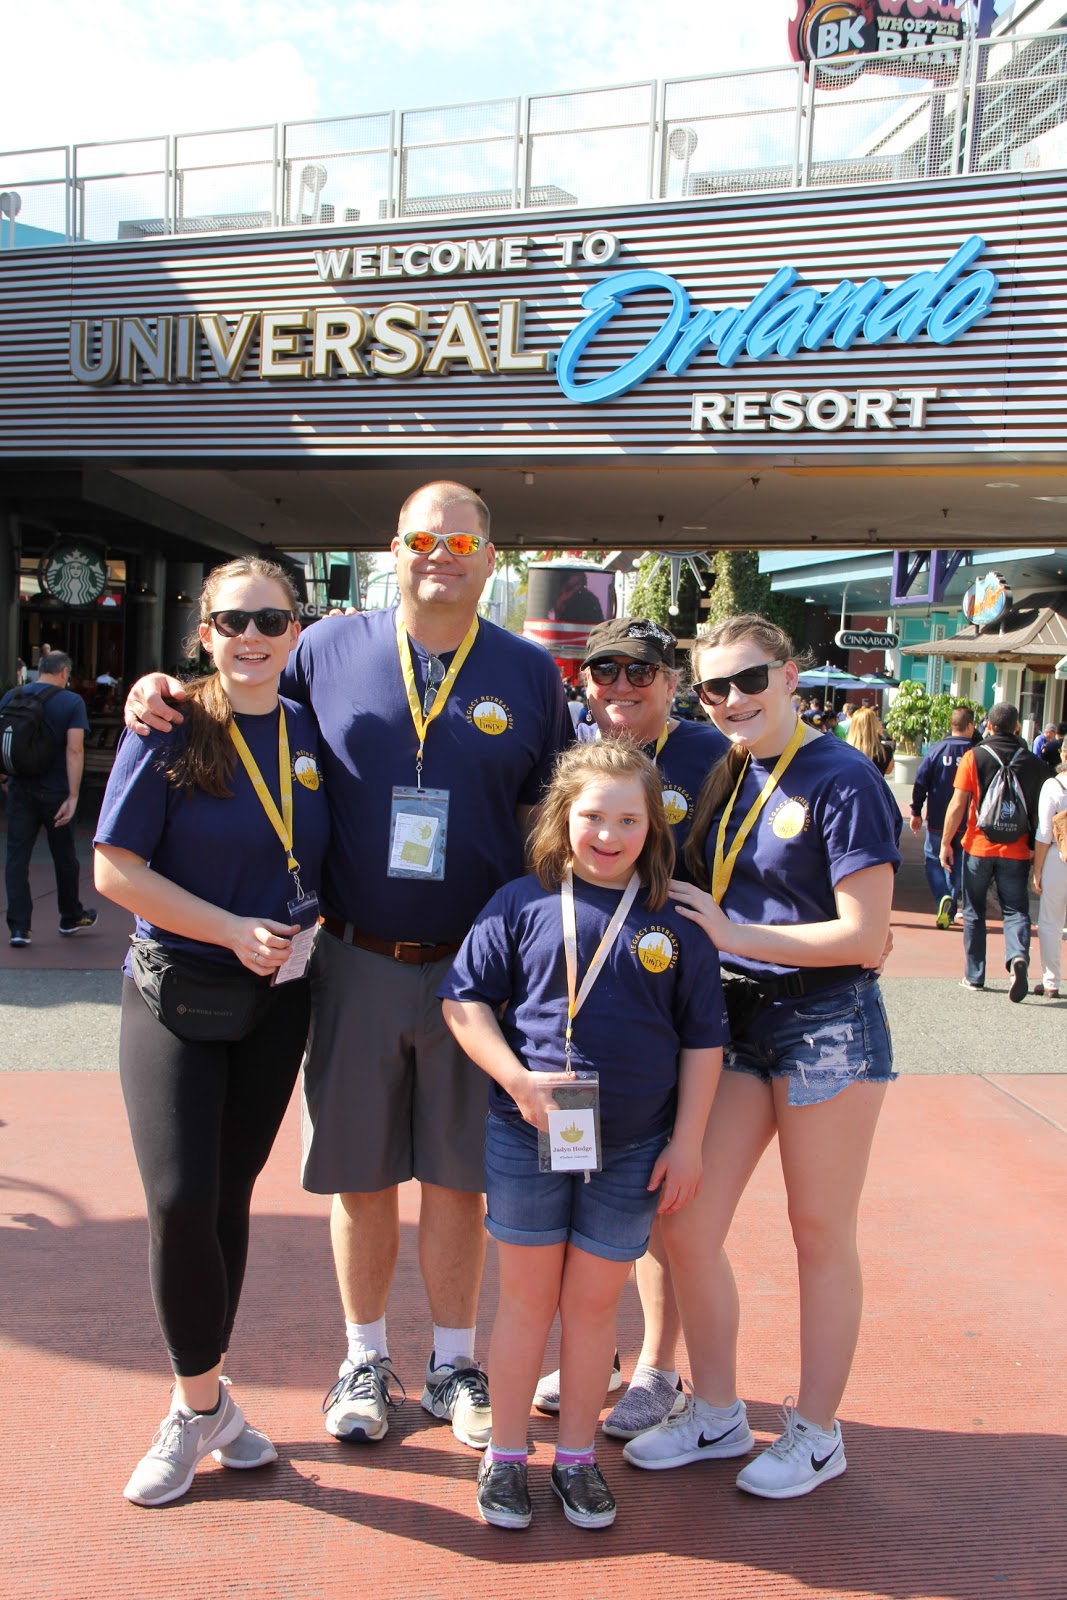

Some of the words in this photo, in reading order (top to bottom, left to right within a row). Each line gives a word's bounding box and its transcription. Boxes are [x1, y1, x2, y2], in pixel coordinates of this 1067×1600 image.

[817, 15, 867, 58] BK
[877, 16, 959, 36] WHOPPER
[877, 30, 957, 66] BAR
[313, 236, 533, 282] WELCOME
[554, 229, 621, 267] TO
[68, 298, 555, 386] UNIVERSAL
[556, 234, 999, 403] Orlando
[690, 386, 940, 432] RESORT
[843, 634, 895, 646] CINNABON
[466, 698, 479, 724] LEGACY
[481, 695, 510, 712] RETREAT
[663, 784, 692, 801] RETREAT
[767, 799, 788, 826] LEGACY
[631, 927, 648, 954] LEGACY
[650, 925, 679, 948] RETREAT
